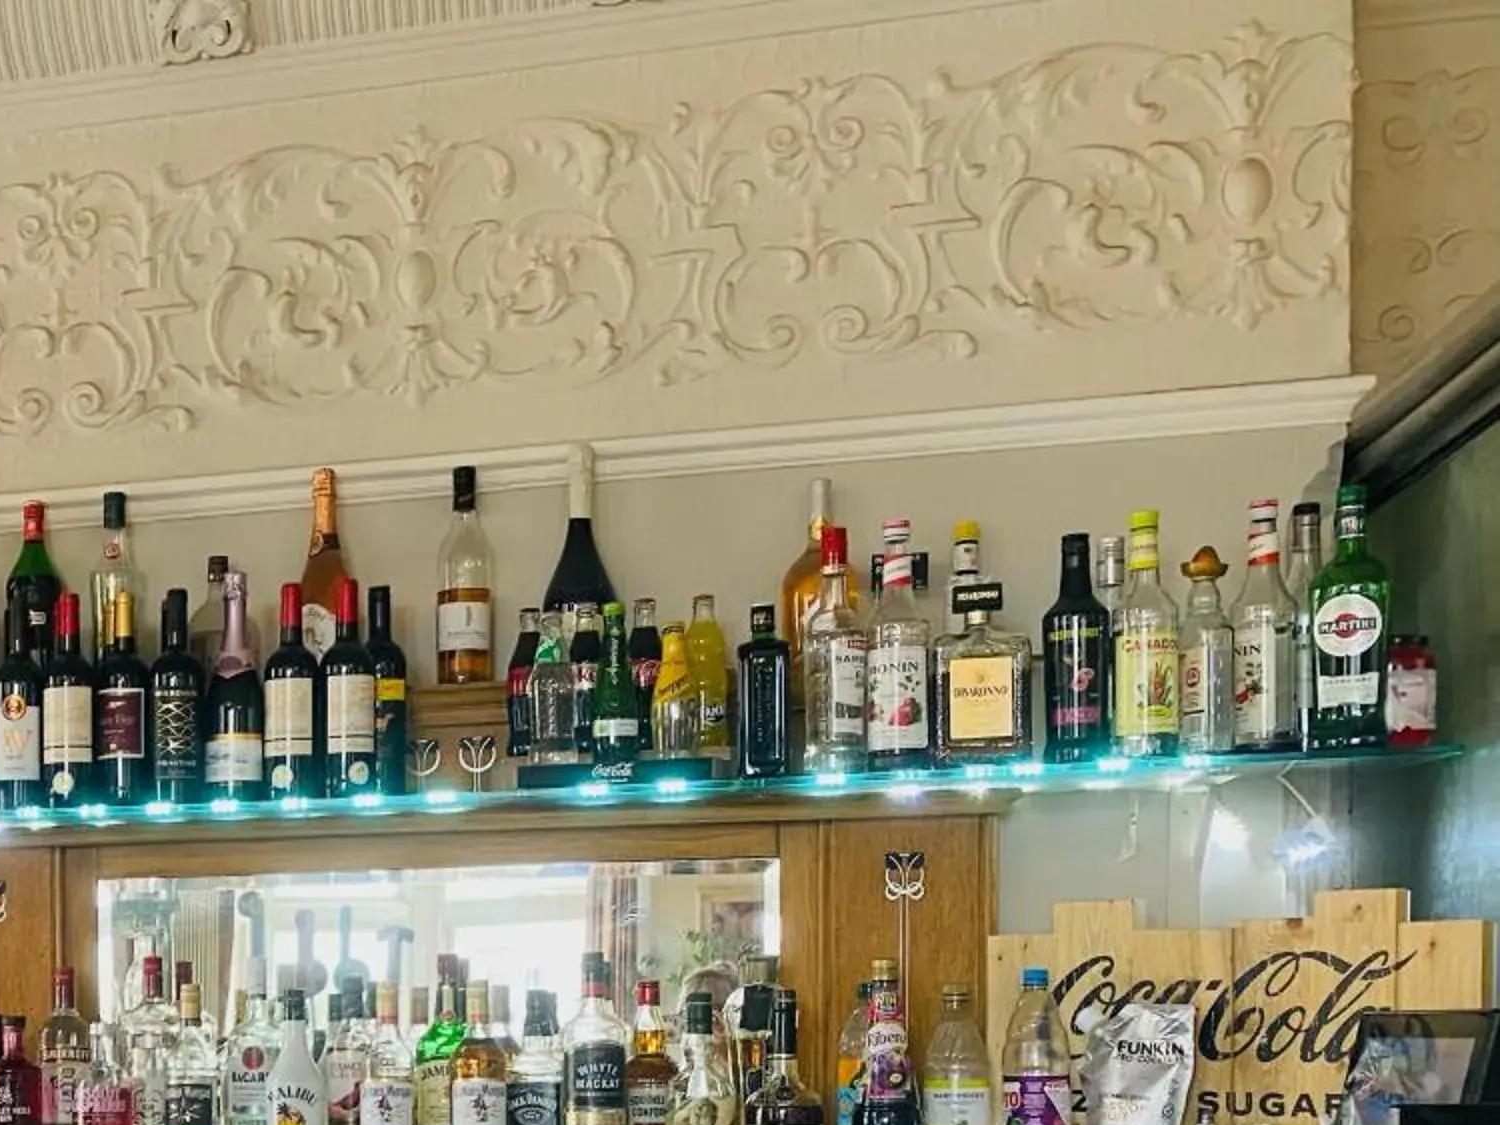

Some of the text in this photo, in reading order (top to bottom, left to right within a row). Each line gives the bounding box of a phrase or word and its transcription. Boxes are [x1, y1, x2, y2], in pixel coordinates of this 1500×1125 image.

[1319, 617, 1376, 633] MARTINI
[953, 686, 1008, 698] DISARONNO
[1117, 1039, 1185, 1057] FUNKIN
[577, 1062, 618, 1077] WHYTE
[575, 1078, 620, 1089] MACKAY
